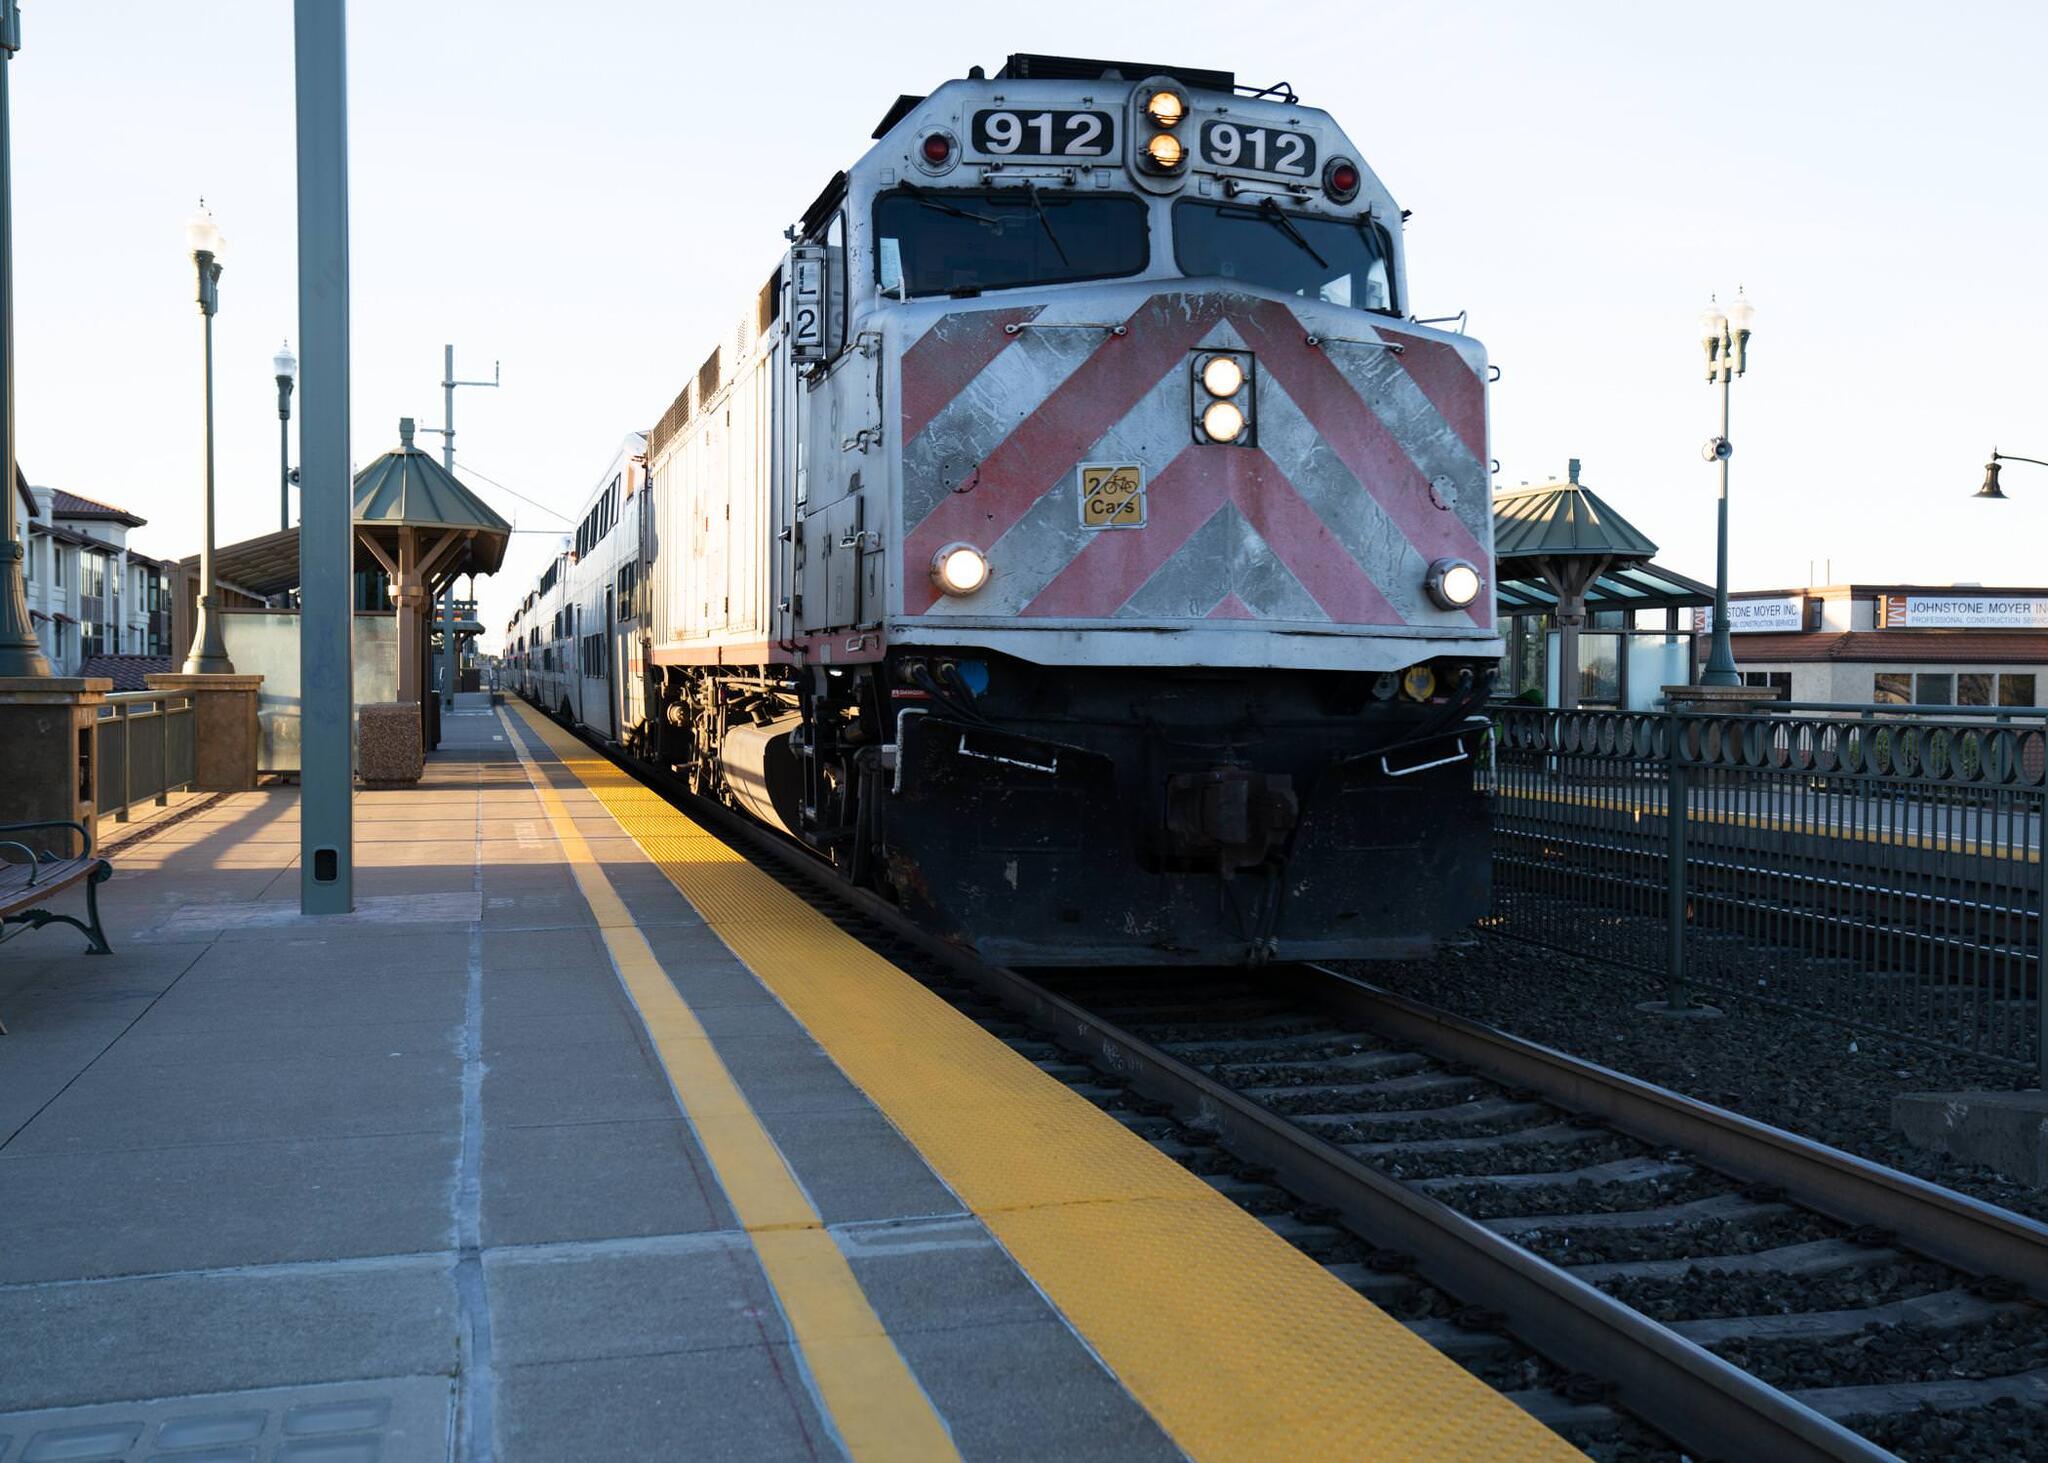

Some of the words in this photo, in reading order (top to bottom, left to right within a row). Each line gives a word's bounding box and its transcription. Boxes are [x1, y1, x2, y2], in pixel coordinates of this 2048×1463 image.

[984, 112, 1103, 155] 912
[1210, 123, 1306, 176] 912
[797, 308, 817, 339] 2
[1088, 477, 1101, 496] 2
[1091, 499, 1135, 515] Cars
[1753, 604, 1781, 617] MOYER
[1910, 602, 1983, 614] JOHNSTONE
[1988, 602, 2031, 614] MOYER
[2035, 602, 2048, 614] IN
[1965, 616, 2020, 624] CONSTRUCTION
